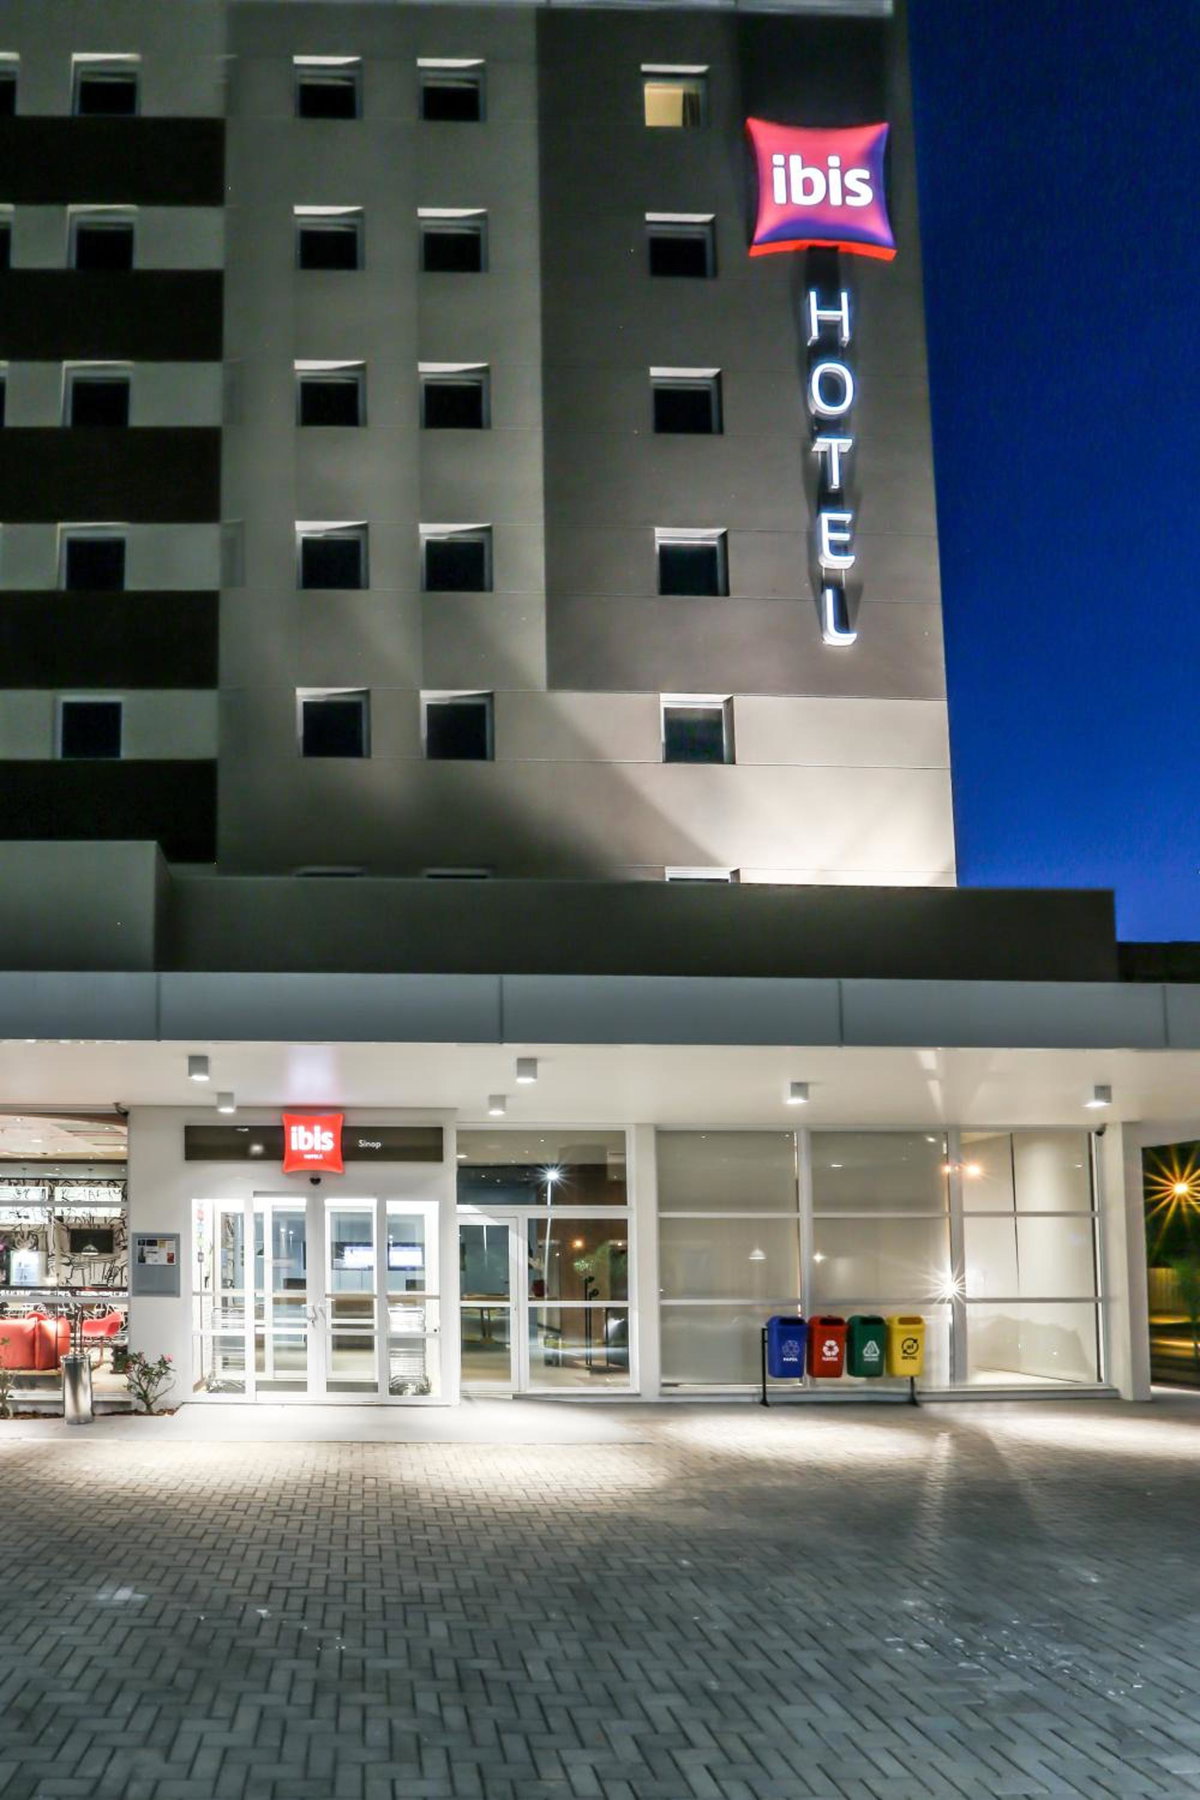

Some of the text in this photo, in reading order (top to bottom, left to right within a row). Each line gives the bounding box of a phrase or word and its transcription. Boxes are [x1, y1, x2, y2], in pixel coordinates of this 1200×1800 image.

[772, 153, 874, 207] ibis
[806, 290, 858, 646] HOTEL
[290, 1125, 334, 1152] ibis
[358, 1139, 382, 1150] Sinop
